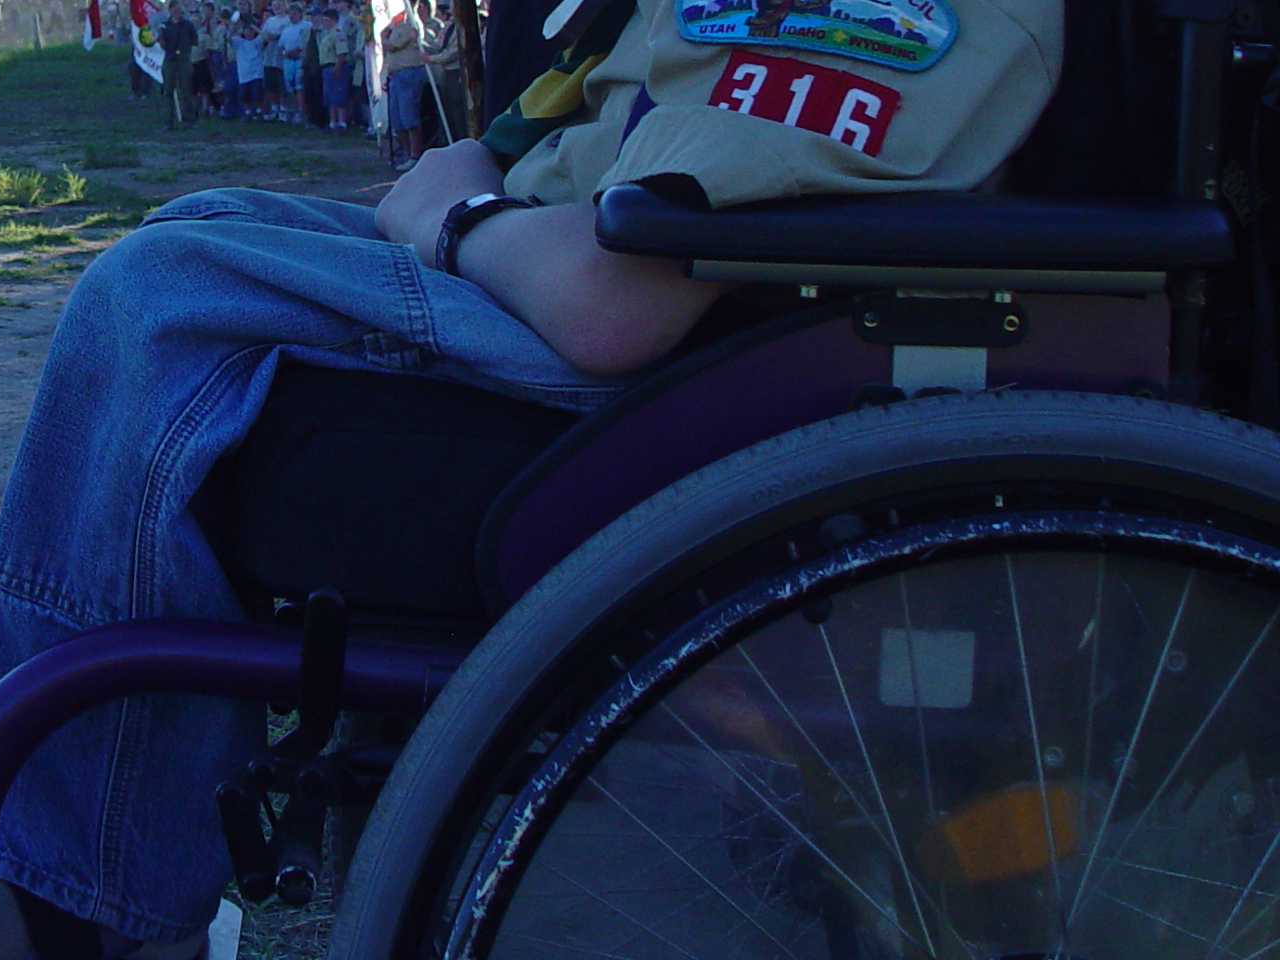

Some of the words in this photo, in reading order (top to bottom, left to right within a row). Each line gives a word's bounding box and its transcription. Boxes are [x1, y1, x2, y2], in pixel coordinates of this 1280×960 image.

[698, 23, 736, 35] UTAH
[781, 23, 827, 40] IDAHO
[848, 35, 919, 62] WYOMING
[717, 62, 882, 153] 316
